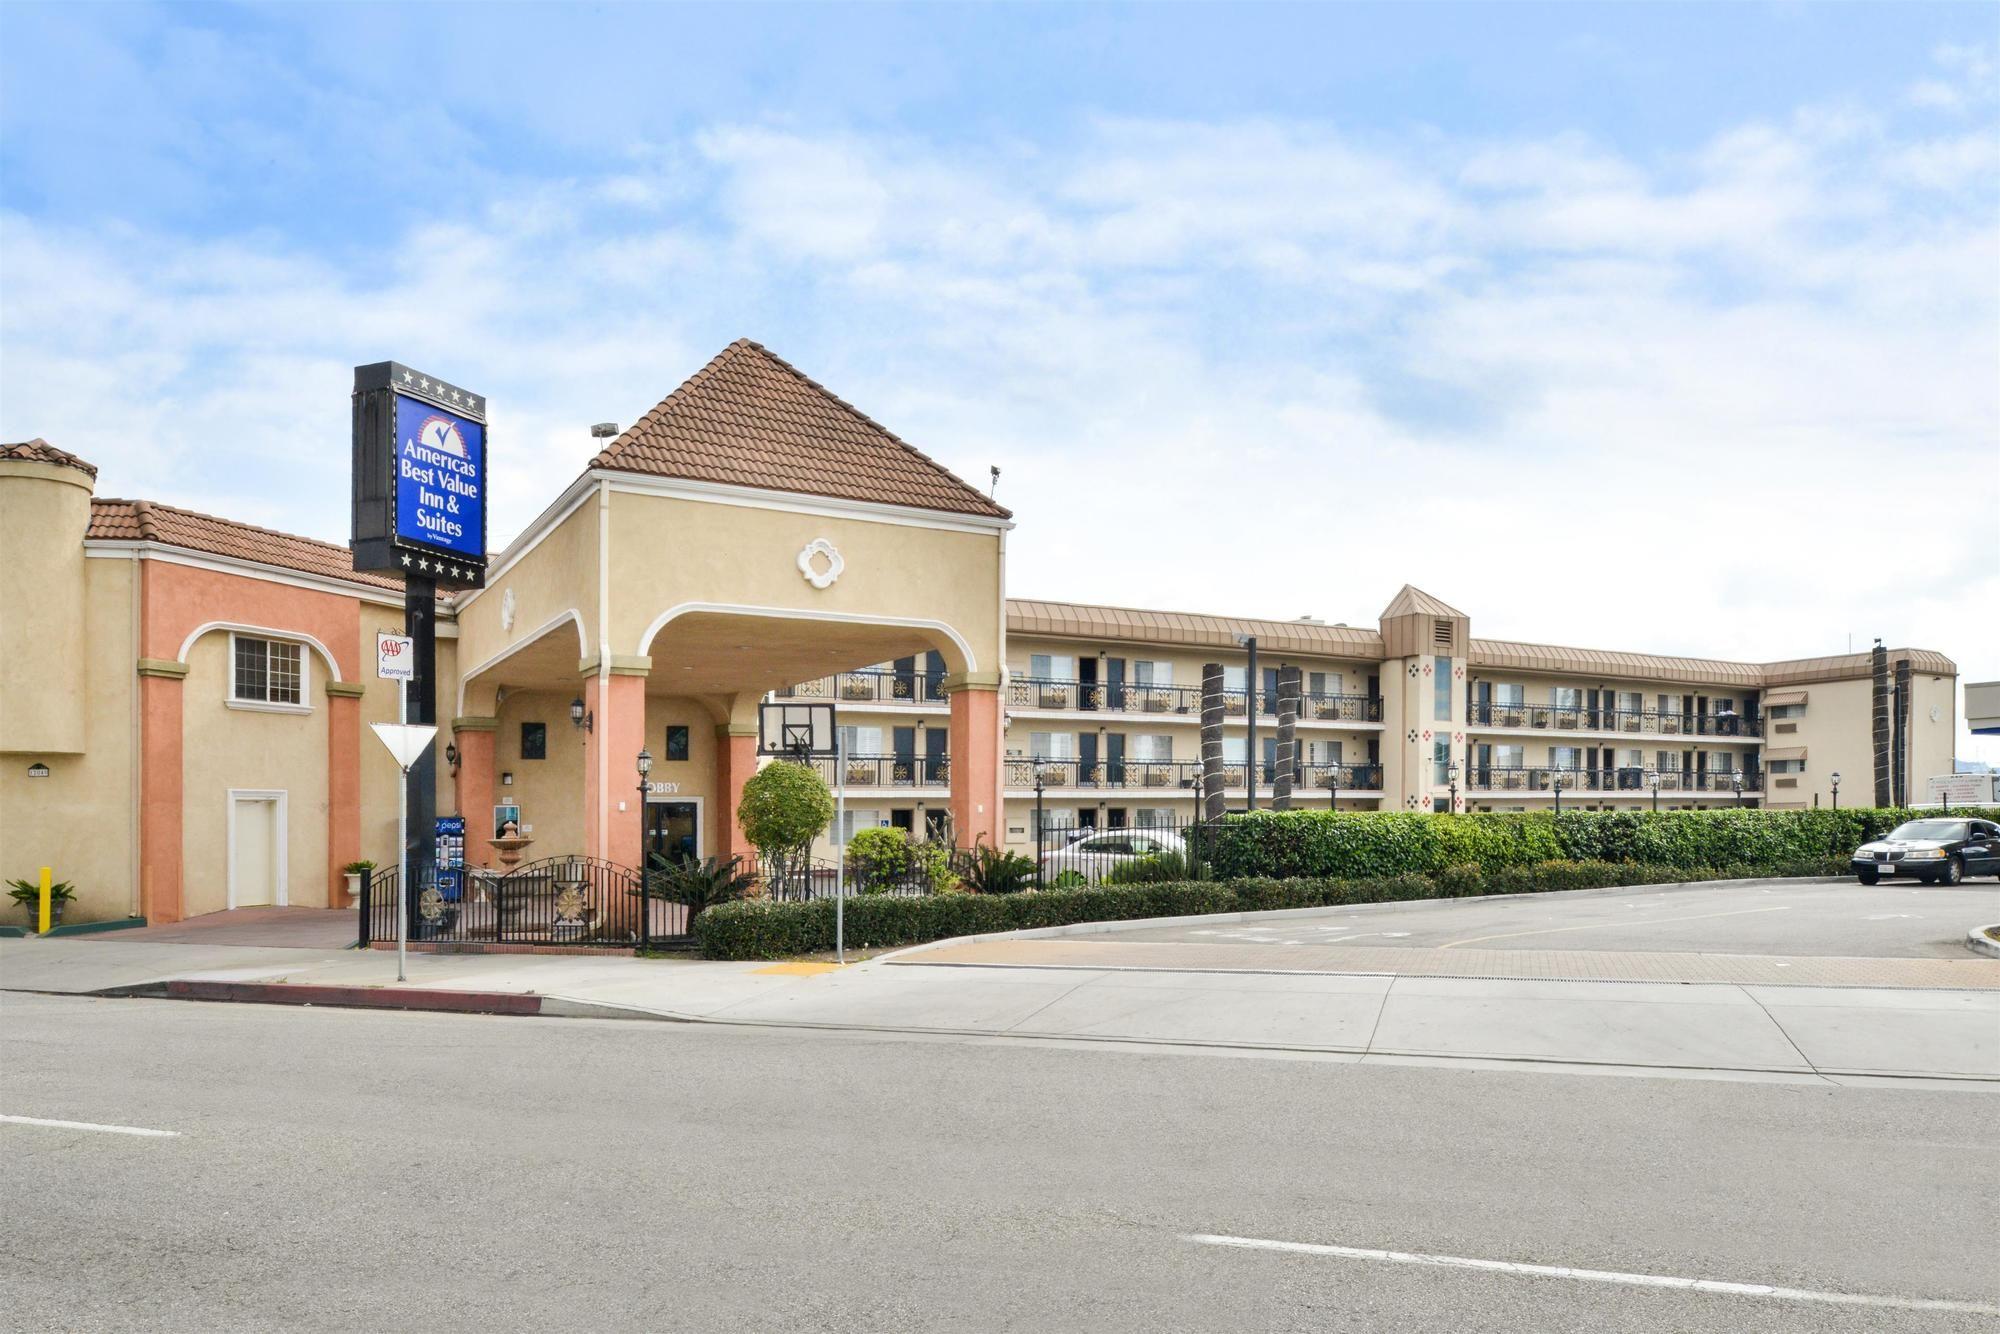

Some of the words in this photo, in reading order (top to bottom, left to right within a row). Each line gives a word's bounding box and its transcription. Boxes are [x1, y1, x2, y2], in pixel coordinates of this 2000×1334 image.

[404, 438, 476, 477] Americas
[401, 458, 434, 486] Best
[438, 470, 478, 498] Value
[420, 486, 444, 510] Inn
[447, 495, 460, 514] &
[416, 508, 463, 537] Suites
[381, 640, 401, 656] AAA
[381, 667, 411, 676] Approved
[645, 782, 681, 793] OBBY
[441, 822, 461, 832] pepsi
